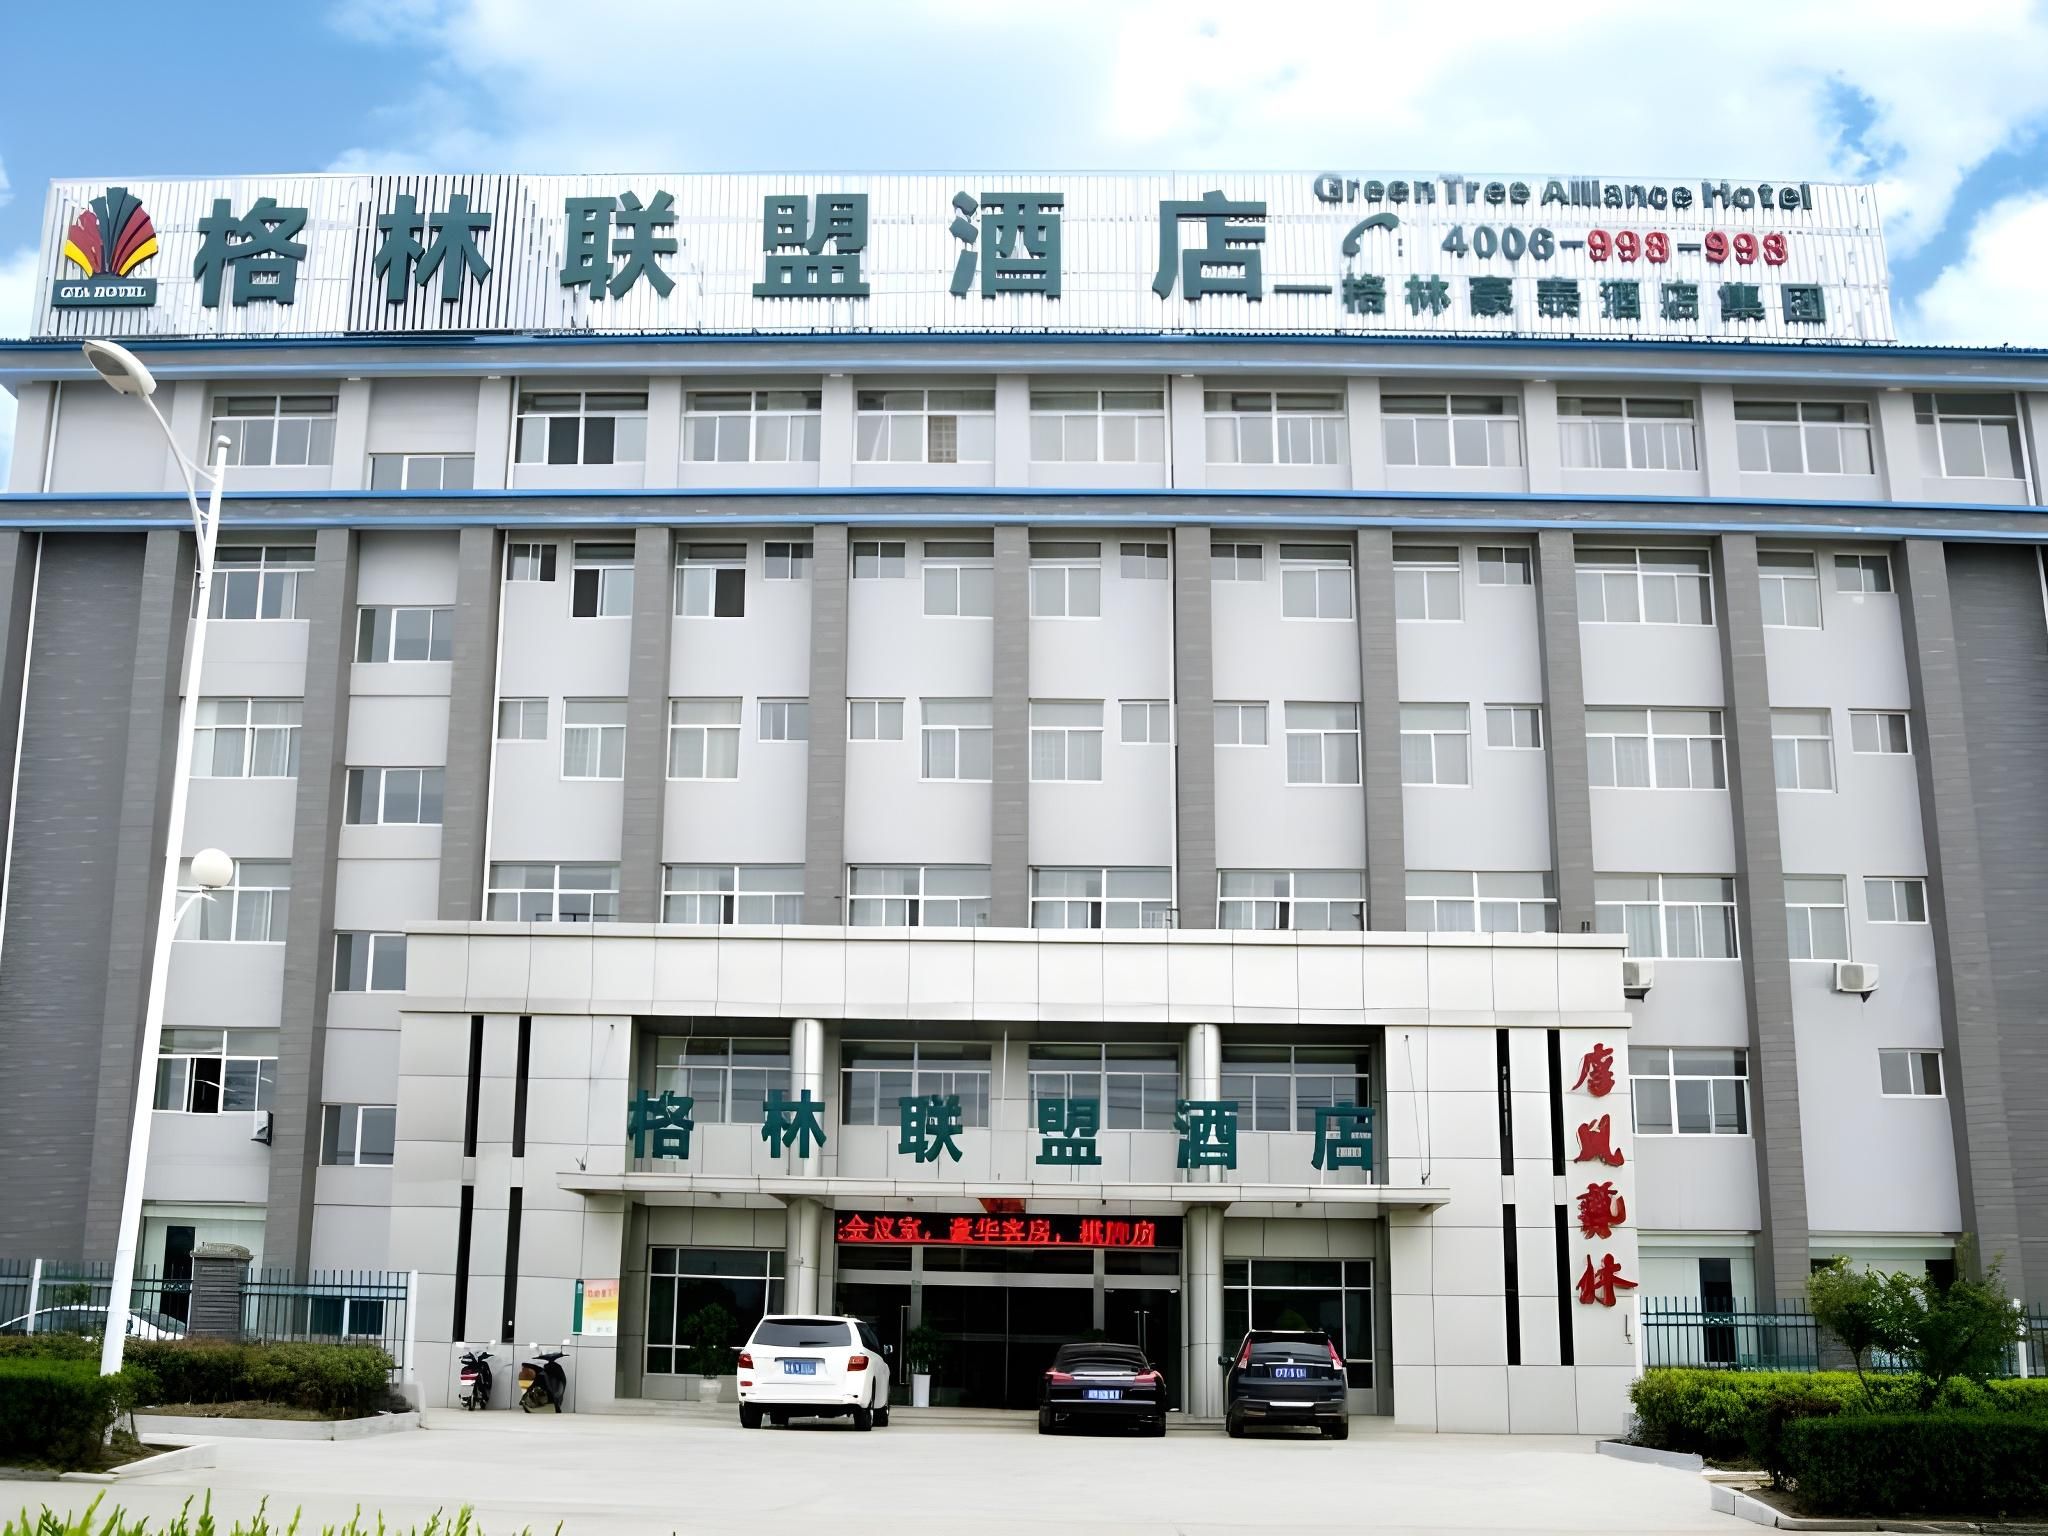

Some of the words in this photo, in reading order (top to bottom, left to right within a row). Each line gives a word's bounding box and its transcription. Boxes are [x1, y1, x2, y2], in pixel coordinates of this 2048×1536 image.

[1701, 179, 1812, 210] Hotel
[193, 189, 1267, 307] 格林联盟酒店
[628, 1088, 1376, 1170] 格林联盟酒店
